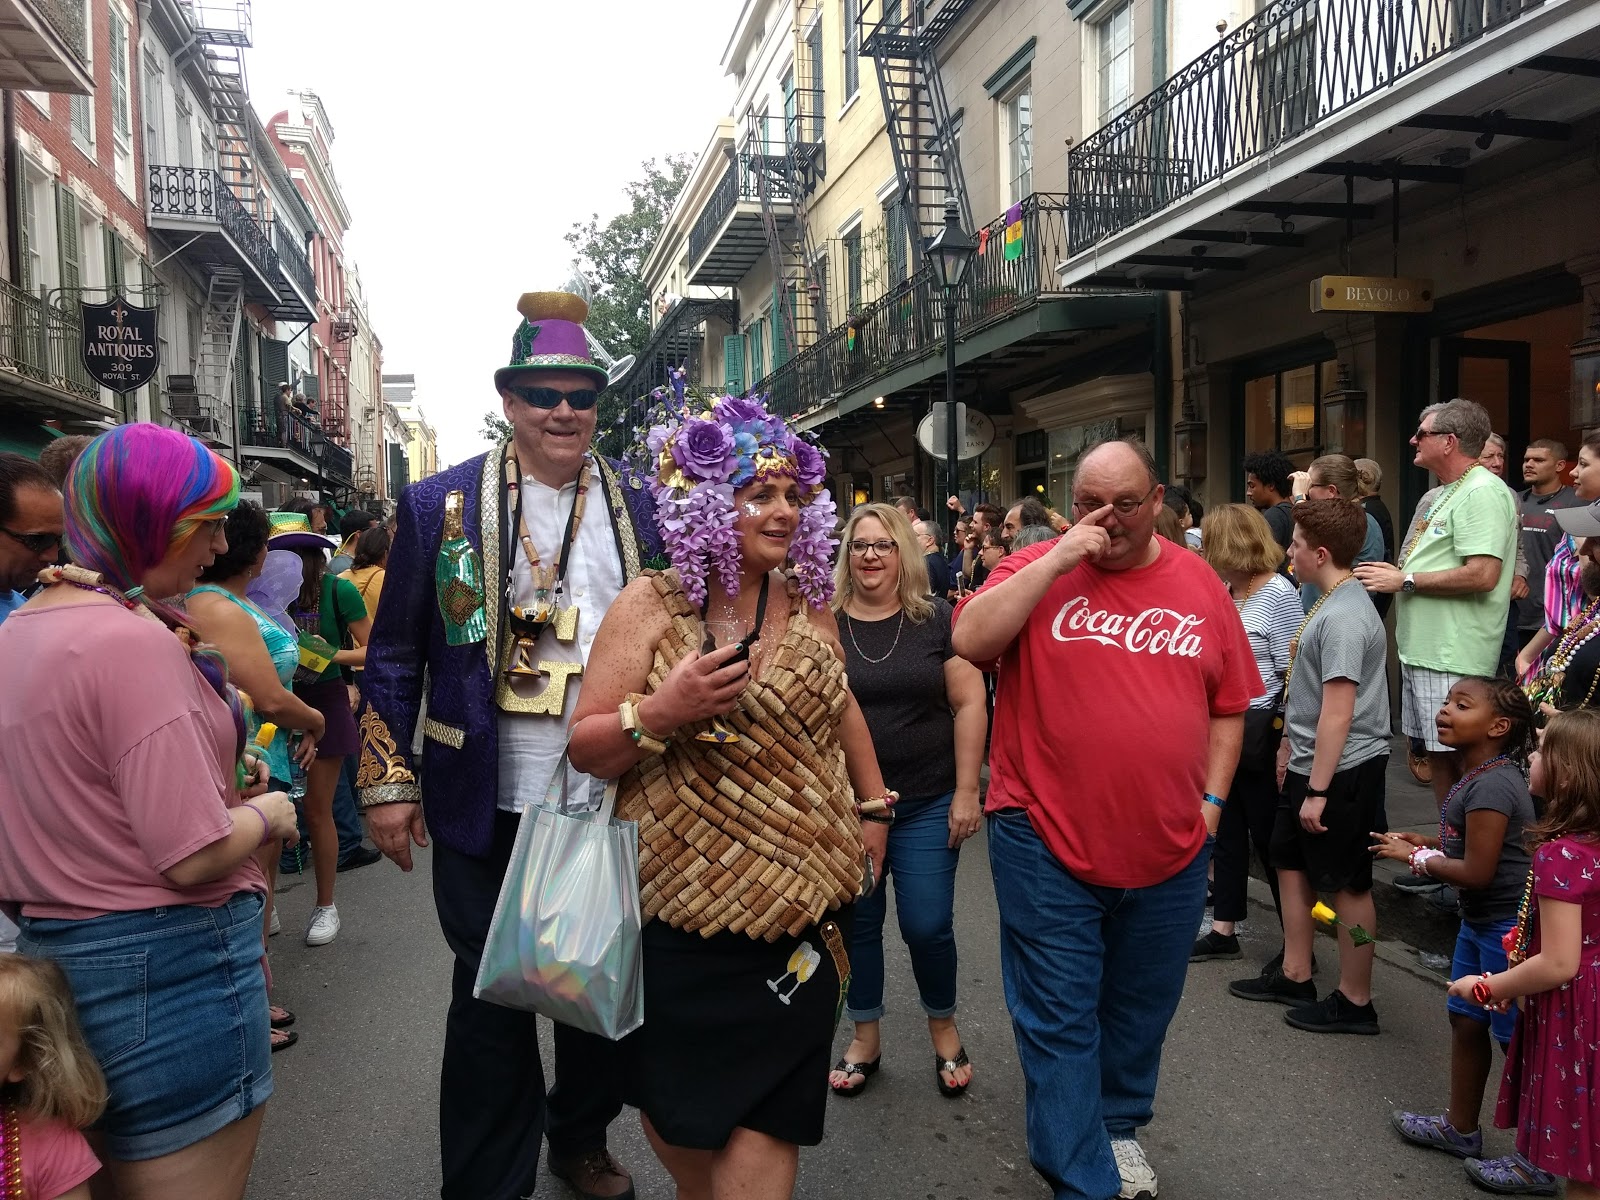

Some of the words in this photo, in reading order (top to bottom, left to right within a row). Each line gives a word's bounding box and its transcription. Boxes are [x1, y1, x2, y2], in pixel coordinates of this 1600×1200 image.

[1346, 286, 1410, 302] BEVOLO
[98, 325, 142, 341] ROYAL
[87, 342, 154, 361] ANTIQUES
[111, 363, 133, 372] 309
[102, 372, 127, 380] ROYAL
[1052, 595, 1206, 659] Coca-Cola
